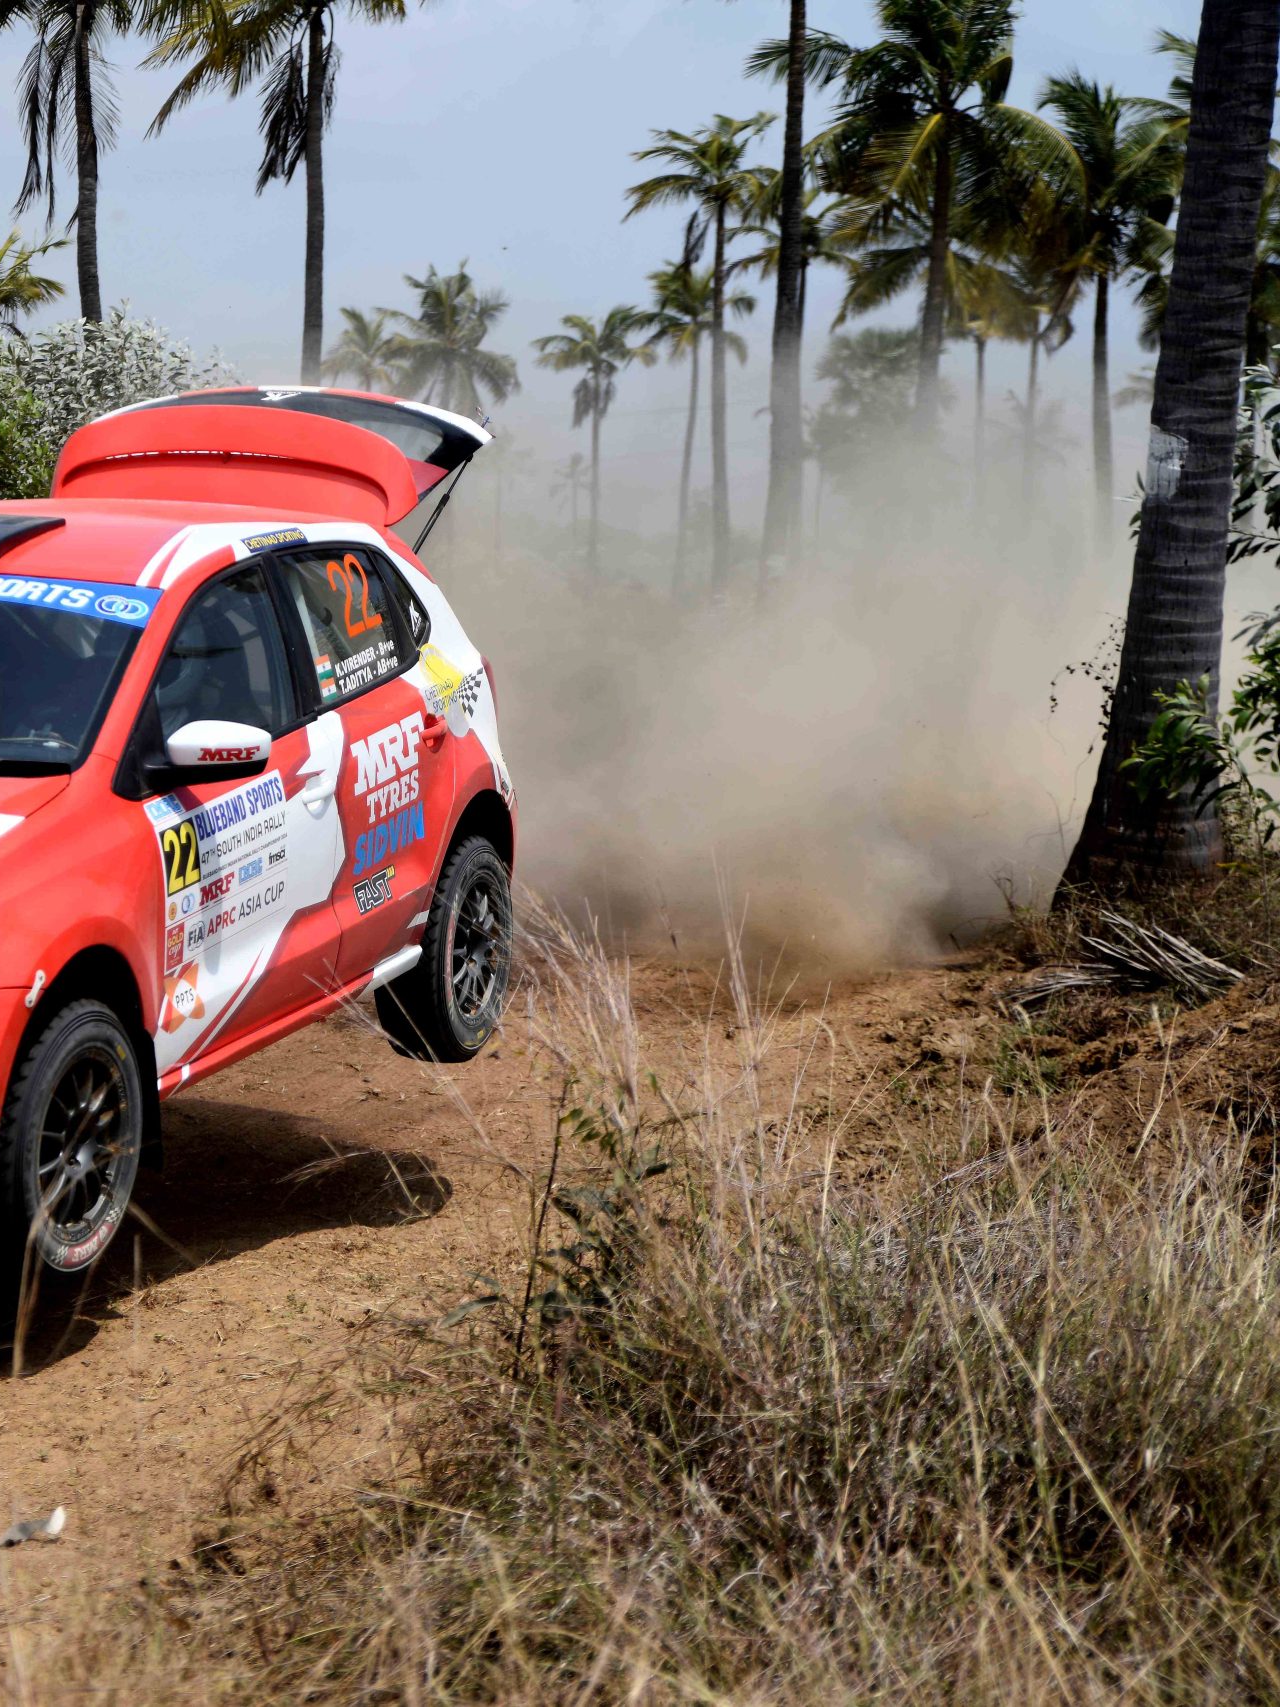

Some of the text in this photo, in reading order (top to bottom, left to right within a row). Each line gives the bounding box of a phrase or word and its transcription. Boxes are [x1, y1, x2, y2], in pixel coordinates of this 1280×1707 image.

[326, 554, 382, 638] 22
[335, 646, 376, 677] K.VIRENDER
[339, 665, 373, 694] T.ADITYA
[197, 745, 260, 762] MRF
[350, 711, 424, 796] MRF
[195, 776, 283, 841] BLUEBAND SPORTS
[366, 769, 419, 824] TYRES
[163, 821, 201, 895] 22
[216, 832, 242, 858] SOUTH
[243, 822, 263, 845] INDIA
[263, 810, 286, 834] RALLY
[353, 800, 424, 876] SIDVIN
[188, 881, 285, 947] FIA APRC ASIA CUP
[199, 872, 234, 907] MRF
[353, 866, 394, 915] FAST
[175, 988, 195, 1008] PPTS
